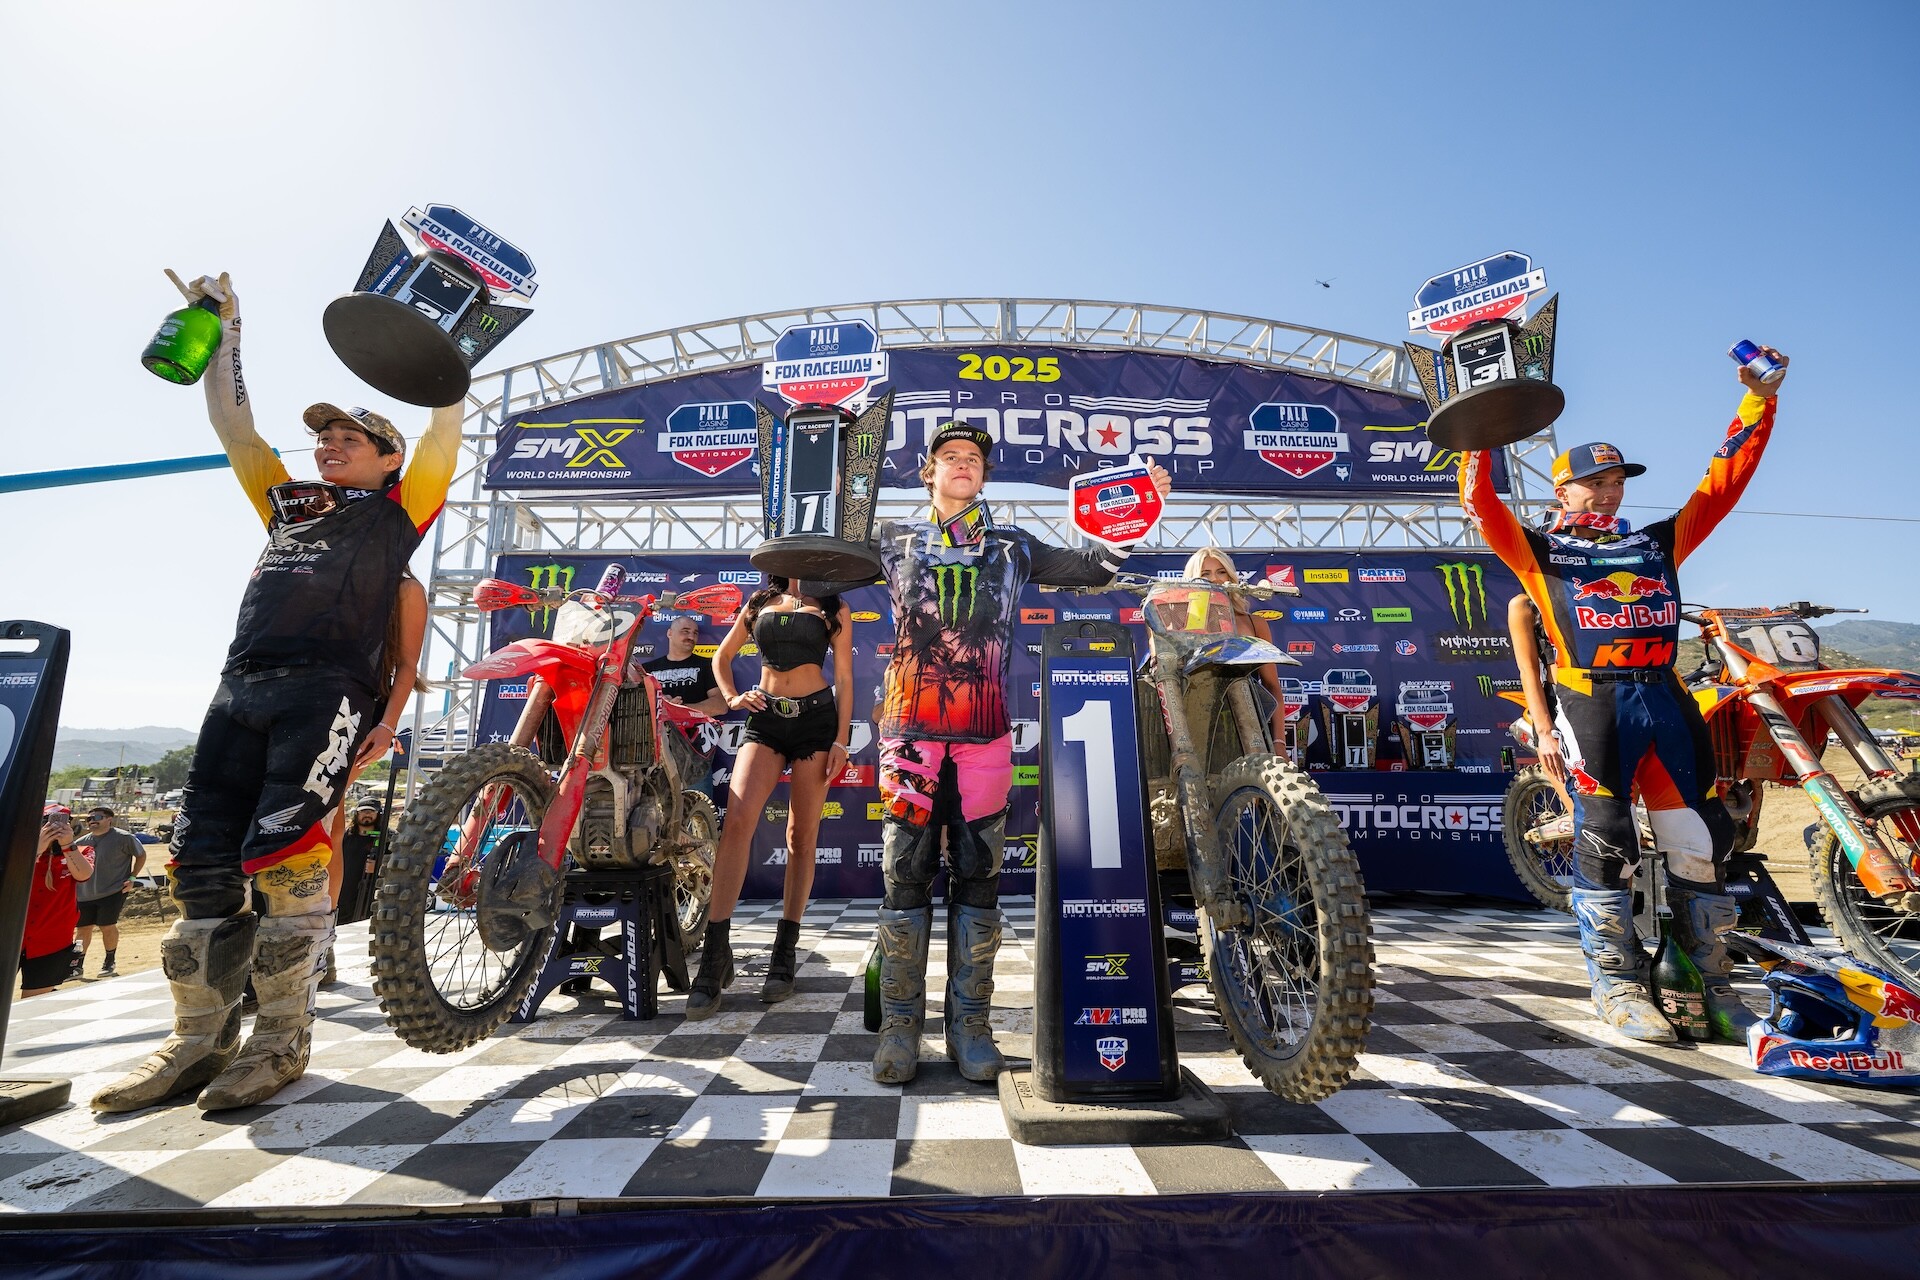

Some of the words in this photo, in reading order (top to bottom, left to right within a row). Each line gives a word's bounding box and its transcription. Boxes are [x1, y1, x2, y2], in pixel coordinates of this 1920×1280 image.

[469, 225, 502, 249] PALA
[420, 218, 453, 241] FOX
[451, 238, 523, 286] RACEWAY
[1453, 265, 1488, 286] PALA
[1421, 306, 1450, 322] FOX
[1452, 277, 1530, 312] RACEWAY
[1439, 300, 1515, 328] NATIONAL
[810, 328, 840, 345] PALA
[1460, 342, 1472, 351] FOX
[1473, 335, 1502, 348] RACEWAY
[810, 344, 840, 353] CASINO
[775, 363, 801, 379] FOX
[804, 358, 872, 376] RACEWAY
[957, 353, 1061, 383] 2025
[1472, 362, 1500, 387] 3
[789, 380, 856, 391] NATIONAL
[958, 391, 1063, 406] PRO
[700, 406, 729, 420] PALA
[1280, 406, 1309, 421] PALA
[698, 420, 729, 428] CASINO
[886, 407, 1213, 456] TOCROSS
[508, 428, 635, 468] SMX
[669, 436, 693, 448] FOX
[696, 433, 757, 447] RACEWAY
[1254, 434, 1278, 447] FOX
[1280, 435, 1338, 448] RACEWAY
[1269, 452, 1327, 460] NATIONAL
[506, 471, 545, 479] WORLD
[547, 471, 632, 479] CHAMPIONSHIP
[1371, 474, 1407, 482] WORLD
[1409, 475, 1459, 483] CHAMPIO
[280, 495, 320, 507] SCOTT
[1100, 500, 1111, 509] FOX
[1111, 497, 1136, 507] RACEWAY
[801, 495, 819, 532] 1
[719, 572, 762, 584] WPS
[1310, 572, 1343, 580] Insta360
[1359, 569, 1404, 577] PARTS
[1186, 592, 1210, 630] 1
[1576, 605, 1633, 629] Red
[1632, 601, 1676, 628] Bull
[1342, 644, 1380, 652] SUZUKI
[1439, 636, 1510, 648] MONSTER
[1737, 625, 1817, 663] 16
[1592, 637, 1674, 667] KTM
[0, 676, 37, 685] CROSS
[1052, 674, 1128, 682] MOTOCROSS
[501, 685, 527, 693] PAR
[697, 721, 719, 753] 30
[1351, 749, 1361, 763] 1
[1430, 750, 1440, 760] 3
[1062, 700, 1122, 869] 1
[1376, 794, 1430, 803] PRO
[1333, 805, 1504, 831] OTOCROSS
[258, 824, 302, 835] HONDA
[1819, 803, 1860, 852] MOTOREX
[1354, 831, 1493, 842] MPIONSHI
[816, 848, 841, 858] PRO
[1063, 904, 1145, 914] MOTOCROSS
[570, 959, 601, 972] SMX
[627, 920, 638, 1017] UFOPLAST
[1086, 958, 1128, 975] SMX
[1074, 1008, 1121, 1025] AMA
[1123, 1008, 1147, 1018] PRO
[1789, 1050, 1849, 1069] Red
[1848, 1051, 1903, 1070] Bull
